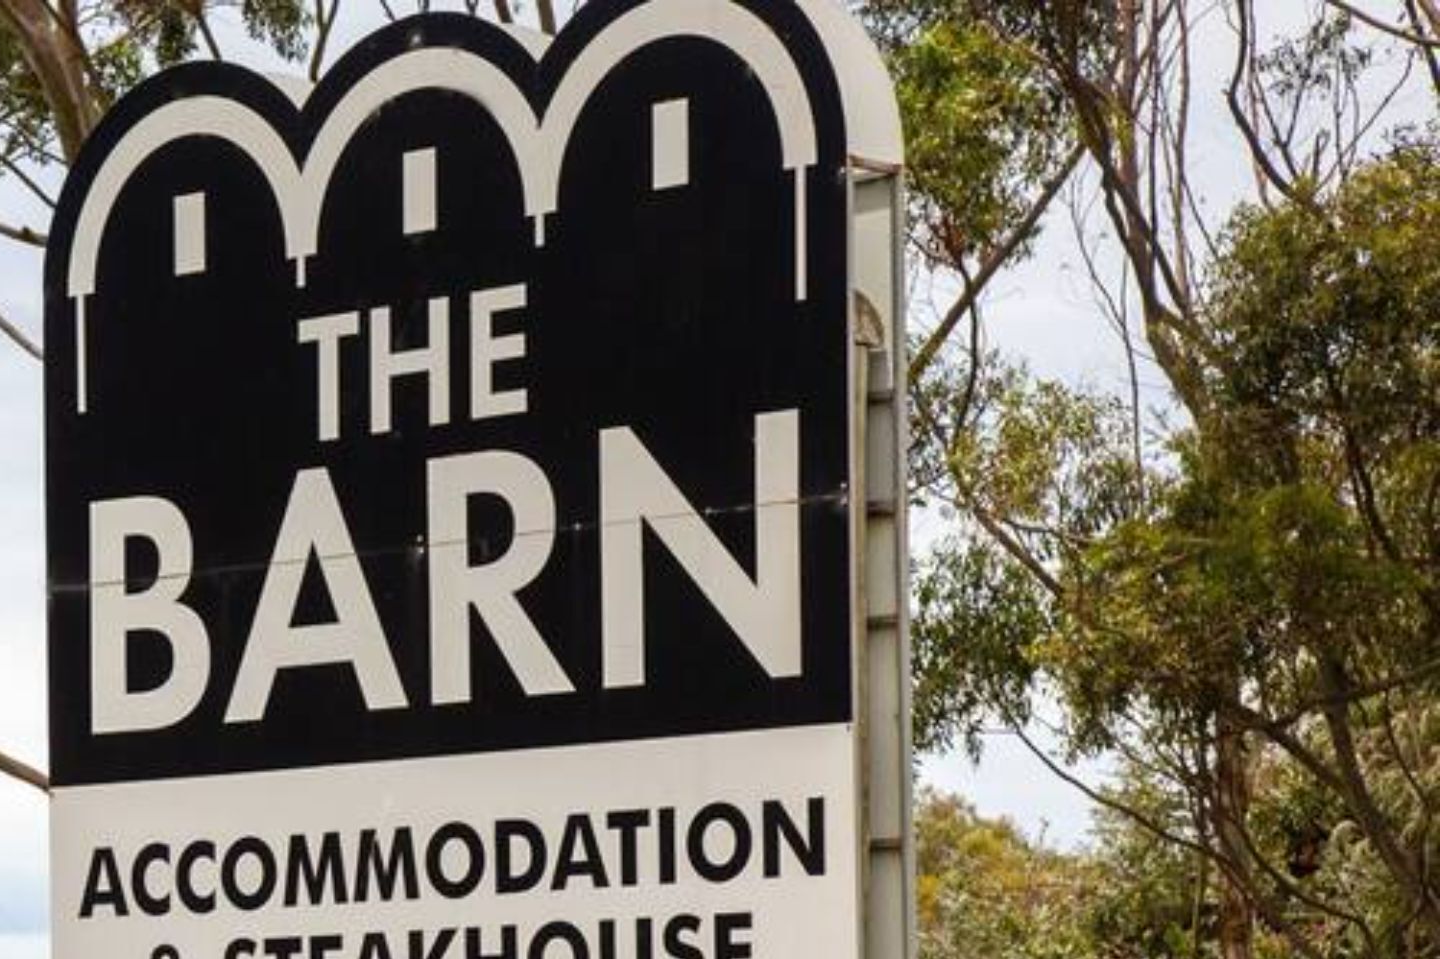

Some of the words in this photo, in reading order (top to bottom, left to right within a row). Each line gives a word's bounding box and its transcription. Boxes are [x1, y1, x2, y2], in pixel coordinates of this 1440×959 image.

[298, 283, 527, 441] THE
[89, 408, 802, 734] BARN
[79, 797, 826, 919] ACCOMMODATION
